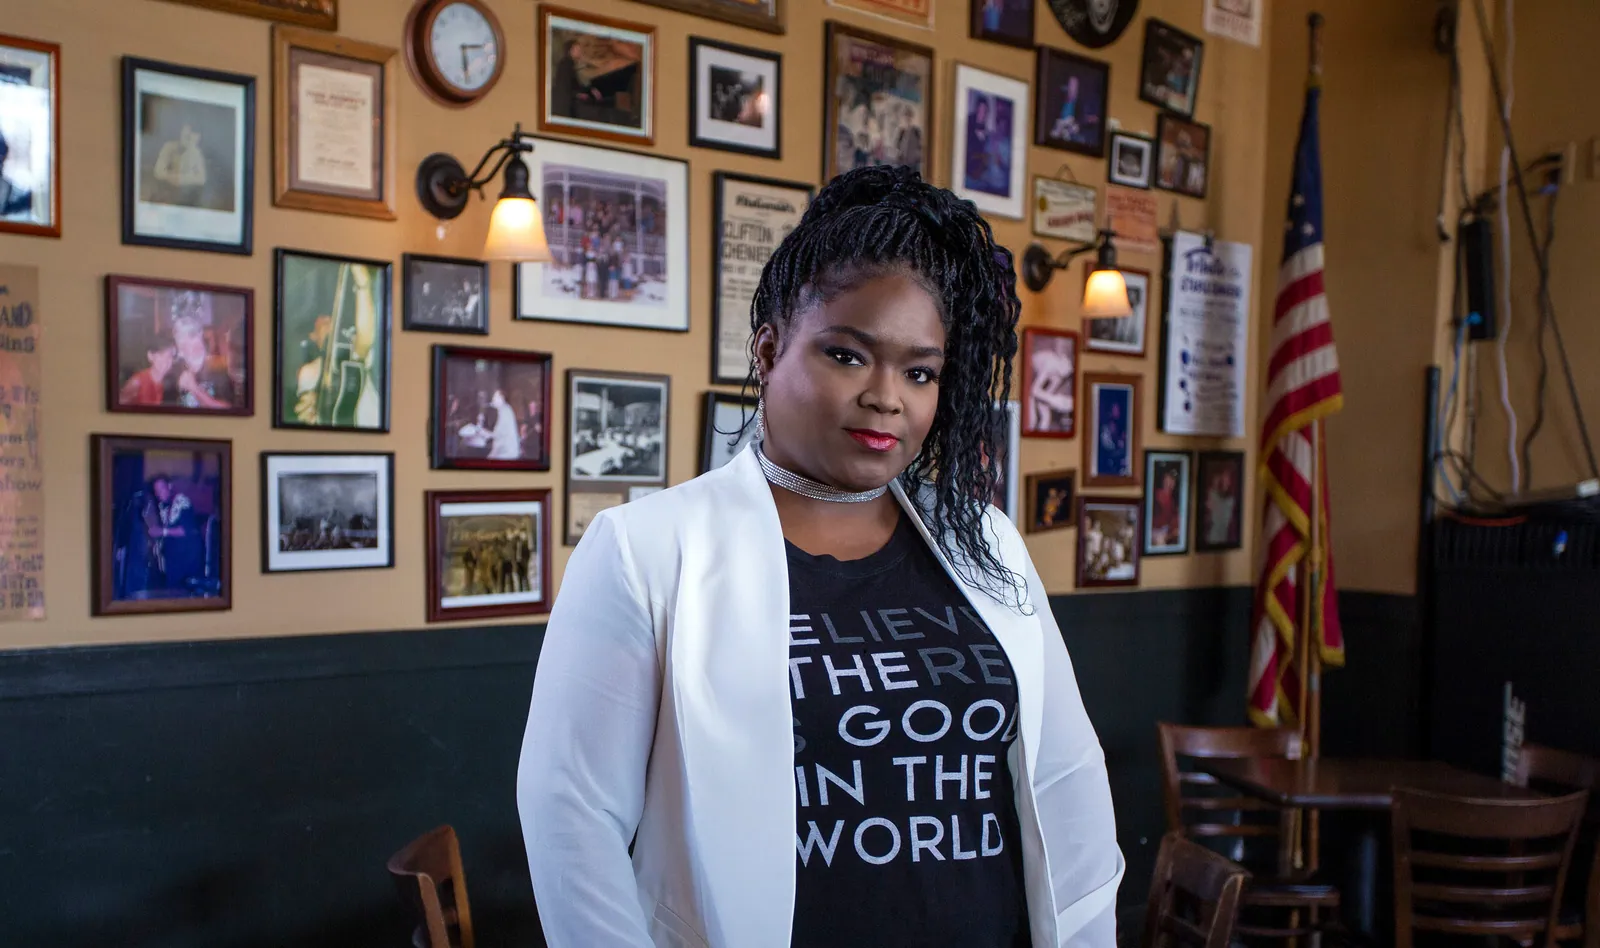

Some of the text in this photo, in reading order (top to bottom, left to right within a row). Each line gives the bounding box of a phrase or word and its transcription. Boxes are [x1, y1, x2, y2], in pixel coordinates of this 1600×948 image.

[789, 644, 1012, 699] THERE
[796, 754, 996, 807] IN THE
[796, 812, 1004, 868] WORLD
